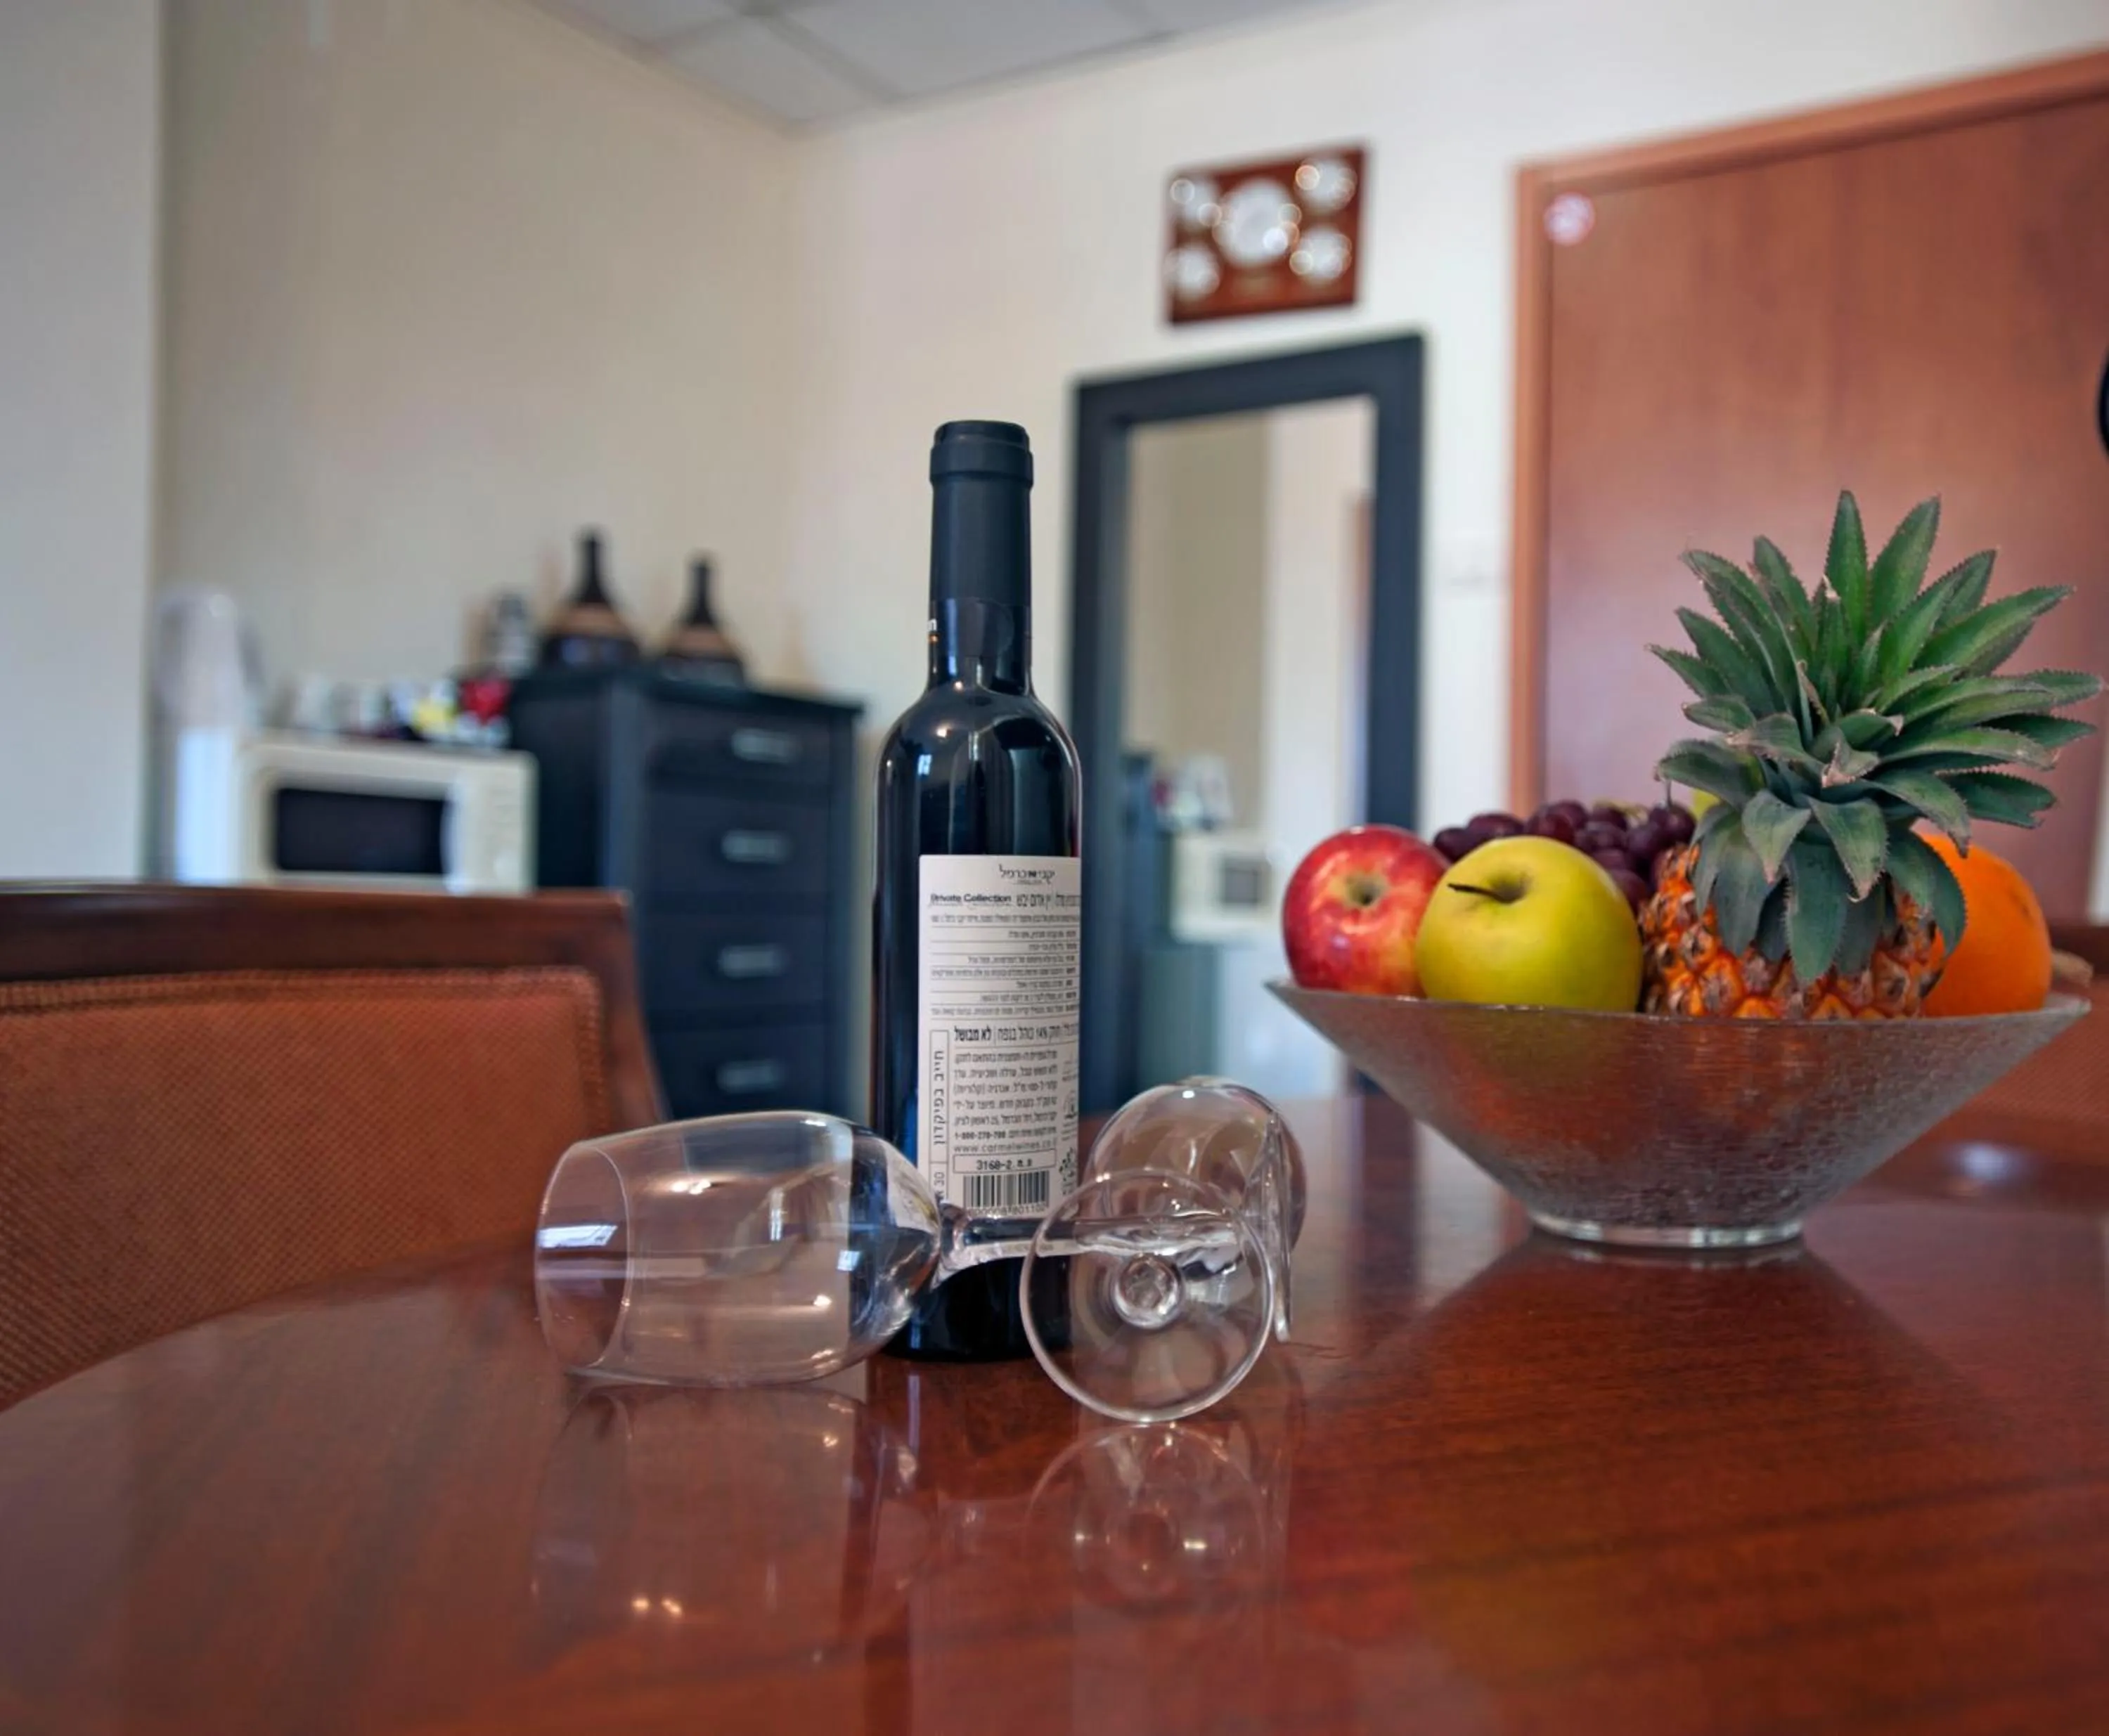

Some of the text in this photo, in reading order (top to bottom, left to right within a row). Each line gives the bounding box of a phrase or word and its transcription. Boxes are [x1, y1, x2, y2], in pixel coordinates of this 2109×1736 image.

[929, 893, 1012, 903] Private Collection
[954, 1025, 991, 1042] לא מבושל
[933, 1050, 948, 1146] חייב בפיקדון
